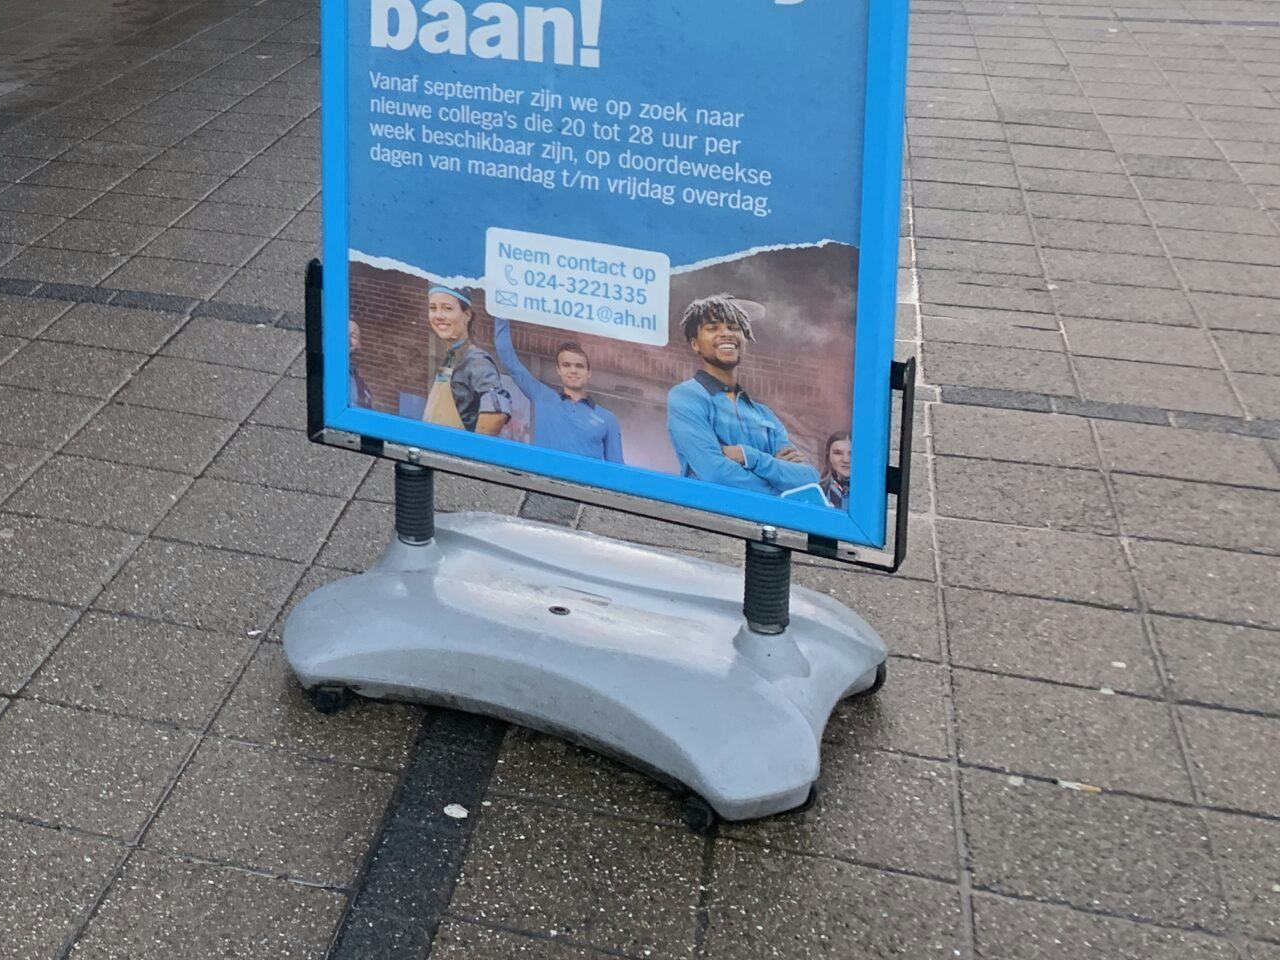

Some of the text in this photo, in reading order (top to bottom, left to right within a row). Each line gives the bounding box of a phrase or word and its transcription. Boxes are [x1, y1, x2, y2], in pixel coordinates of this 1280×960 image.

[370, 71, 744, 128] Vanaf september zijn we op zoek naar
[370, 96, 741, 156] nieuwe collega's die 20 tot 28 uur per
[369, 120, 772, 186] week beschikbaar zijn, op doordeweekse
[370, 143, 771, 217] dagen van maandag t/m vrijdag overdag.
[498, 242, 656, 284] Neem contact op
[524, 270, 647, 305] 024-3221335
[523, 295, 657, 331] mt.1021@ah.nl
